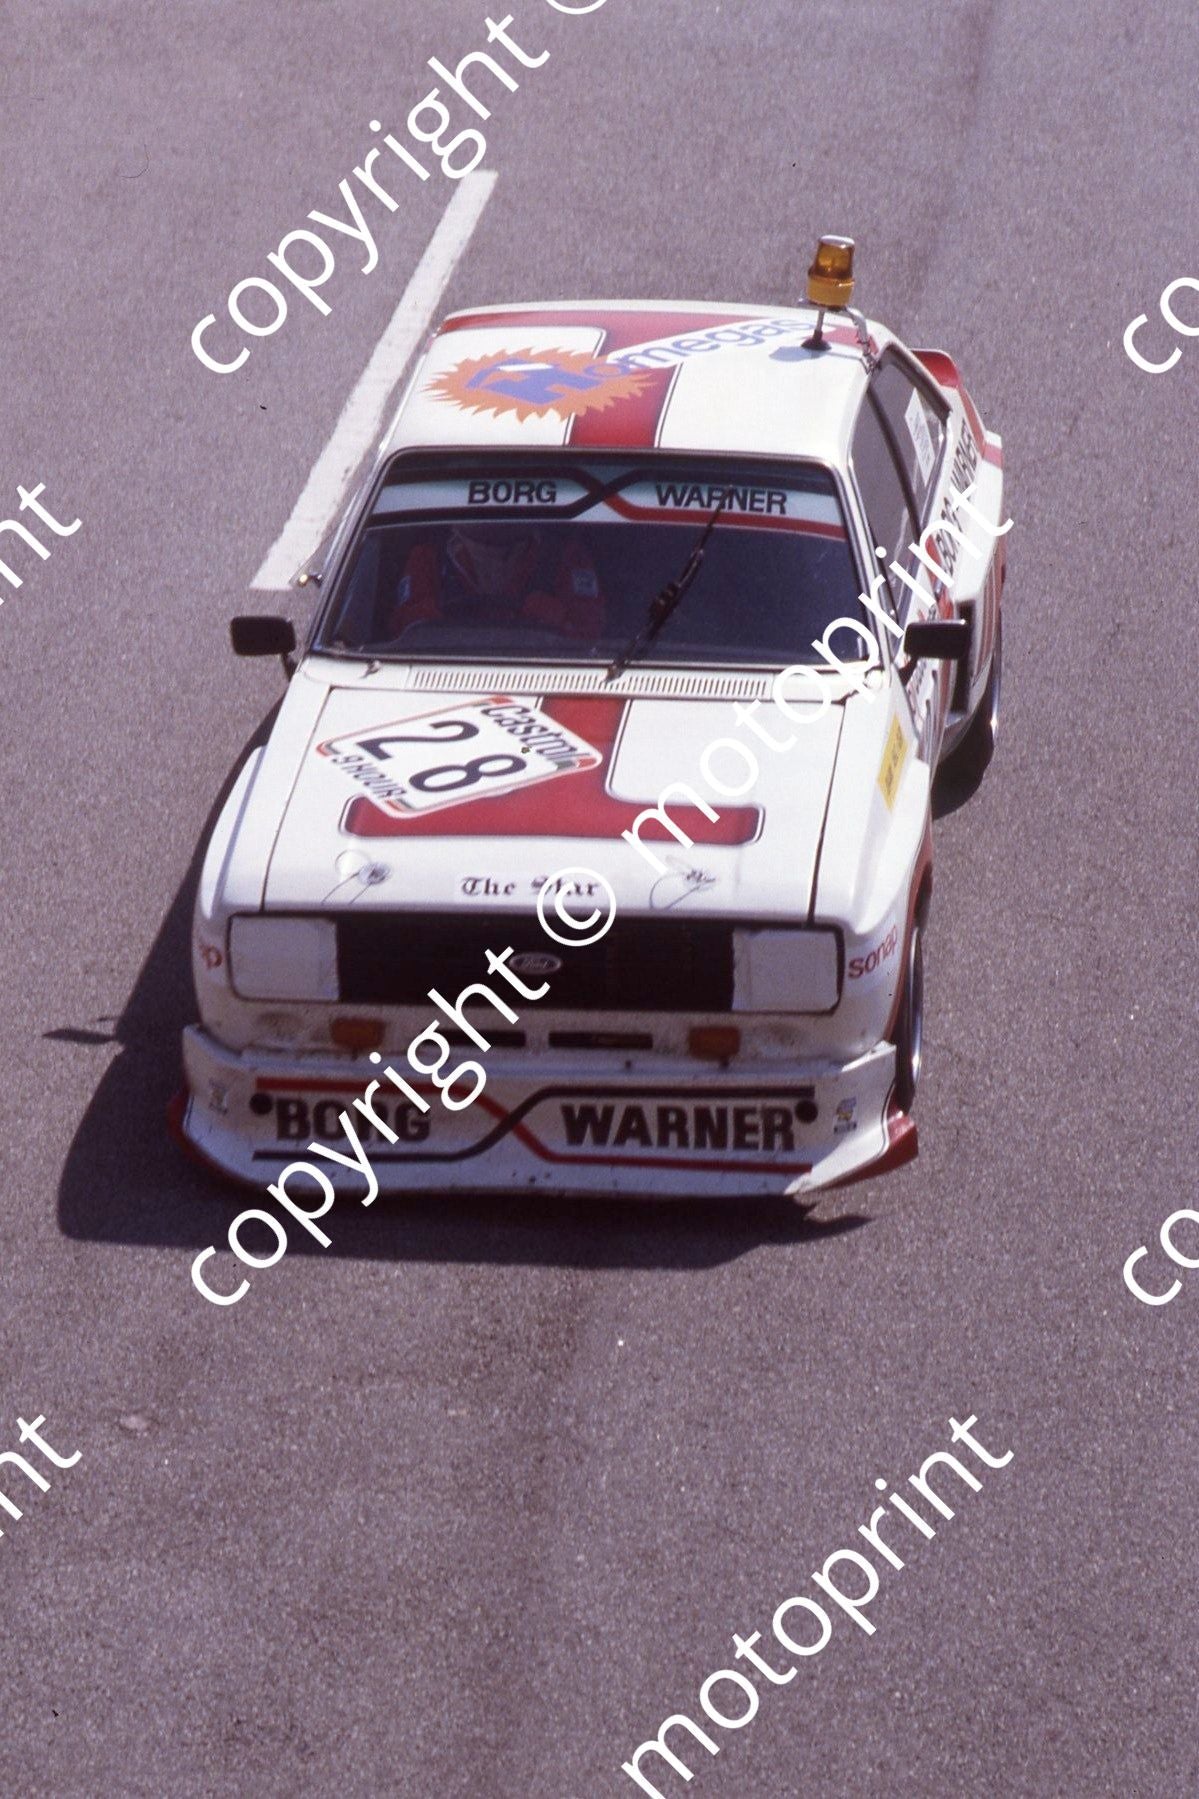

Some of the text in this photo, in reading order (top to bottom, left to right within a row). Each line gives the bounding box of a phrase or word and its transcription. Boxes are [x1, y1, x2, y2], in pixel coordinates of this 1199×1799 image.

[467, 480, 787, 515] BORG WARNER
[356, 720, 527, 792] 28
[461, 876, 516, 897] The
[562, 1103, 797, 1151] WARNER
